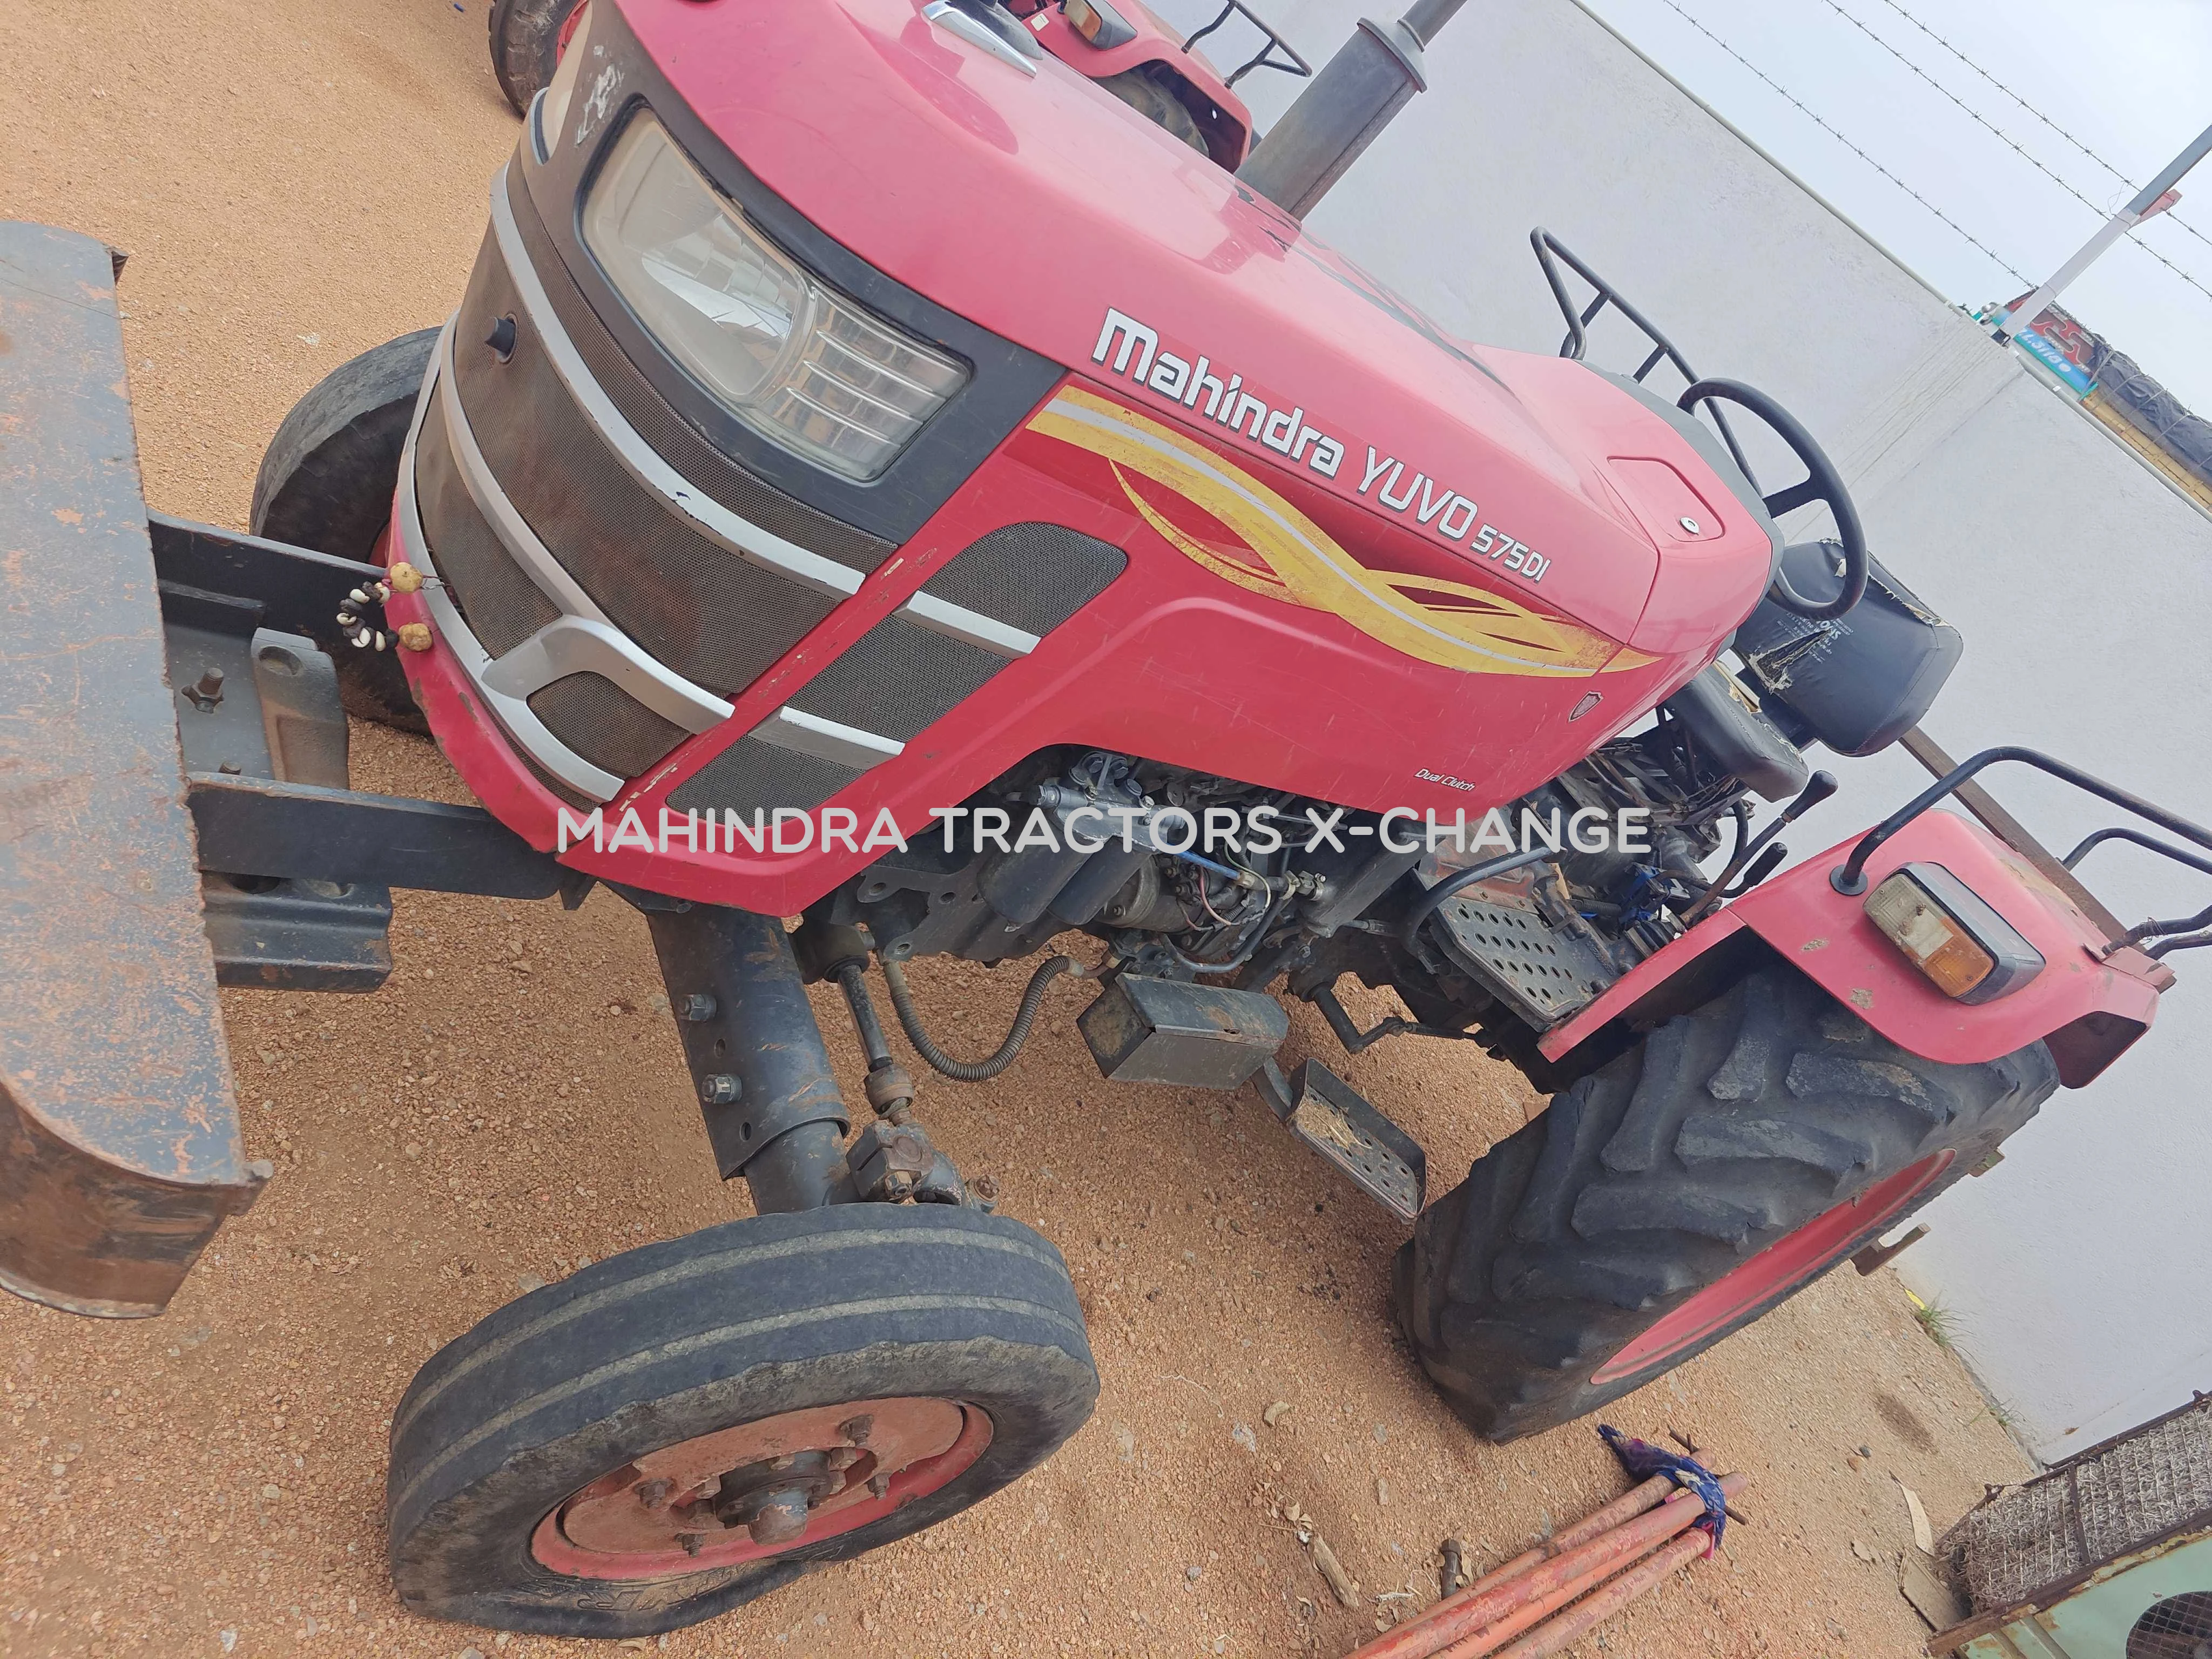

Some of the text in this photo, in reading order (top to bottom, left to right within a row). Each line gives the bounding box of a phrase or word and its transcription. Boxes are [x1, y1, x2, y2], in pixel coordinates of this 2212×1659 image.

[1091, 306, 1551, 583] Mahindra YUVO 575DI
[1414, 768, 1476, 791] Dual Clutch
